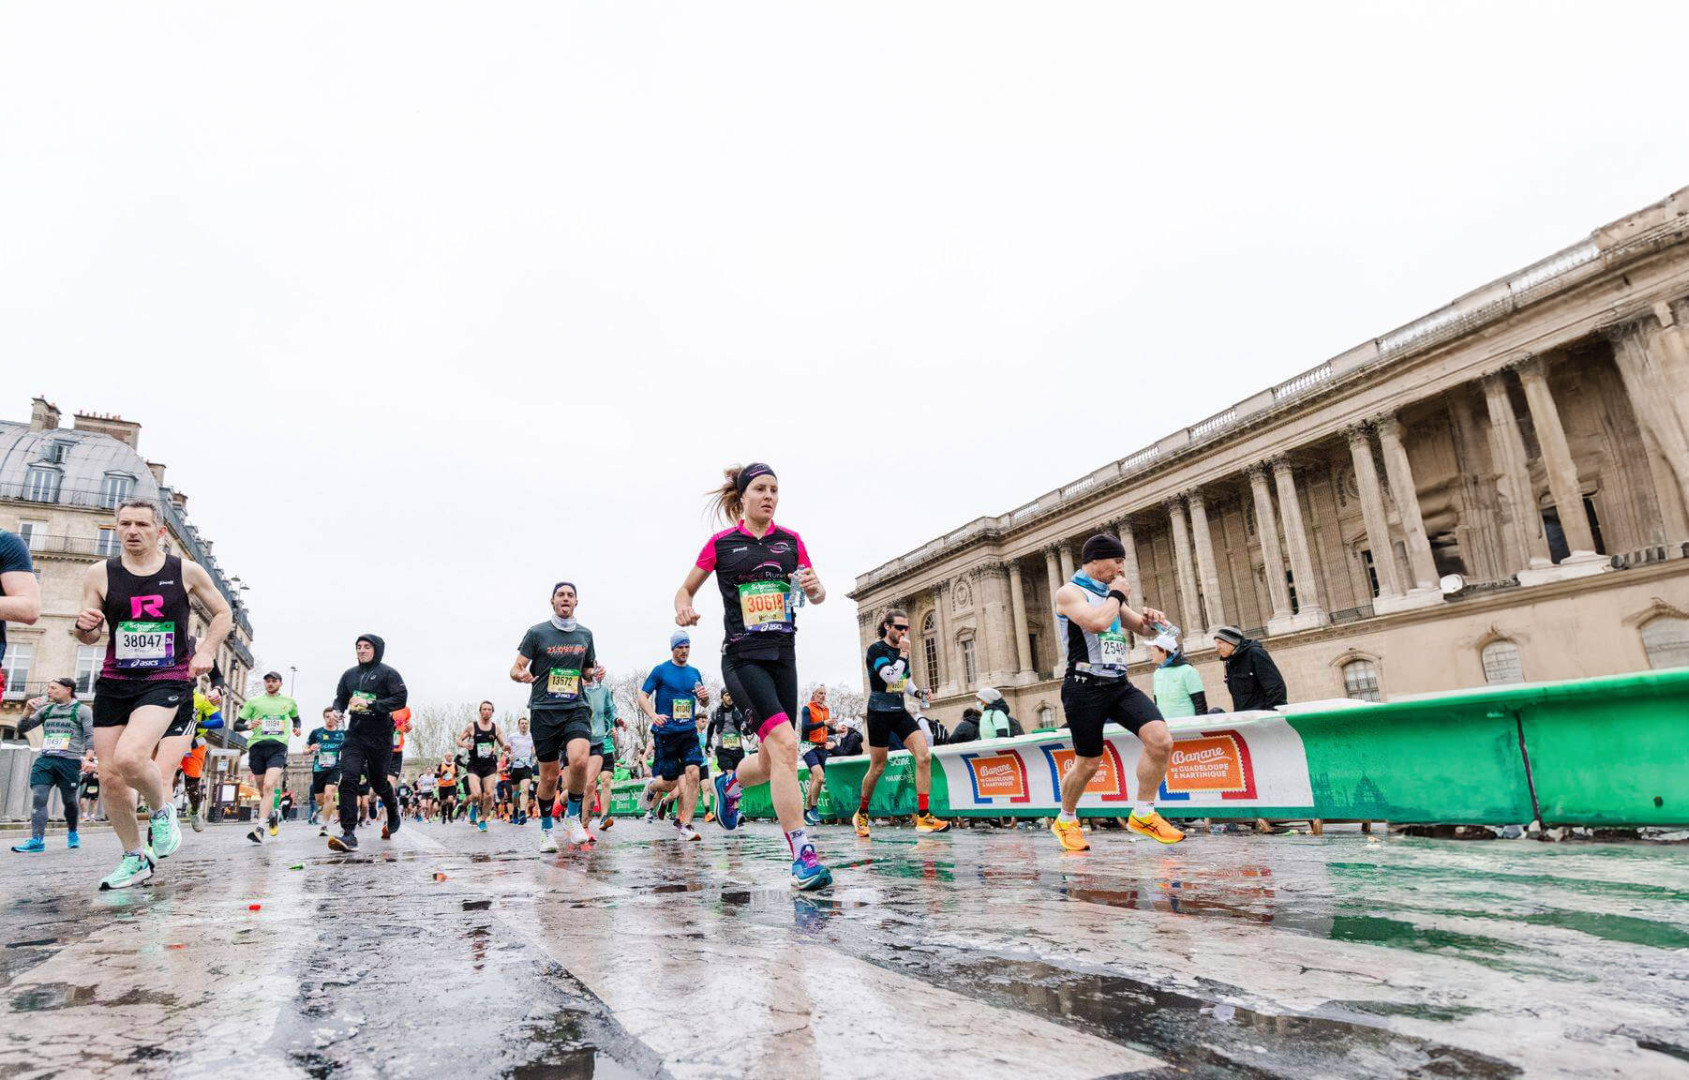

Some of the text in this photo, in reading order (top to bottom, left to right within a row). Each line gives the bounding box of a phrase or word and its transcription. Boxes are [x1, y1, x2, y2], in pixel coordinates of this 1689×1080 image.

[130, 594, 165, 619] R
[747, 594, 783, 613] 30618
[123, 634, 162, 648] 38047
[552, 676, 573, 687] 13572
[1171, 746, 1233, 765] Banane
[1178, 763, 1229, 773] GUADELOUPE
[1180, 770, 1227, 779] MARTINIQUE
